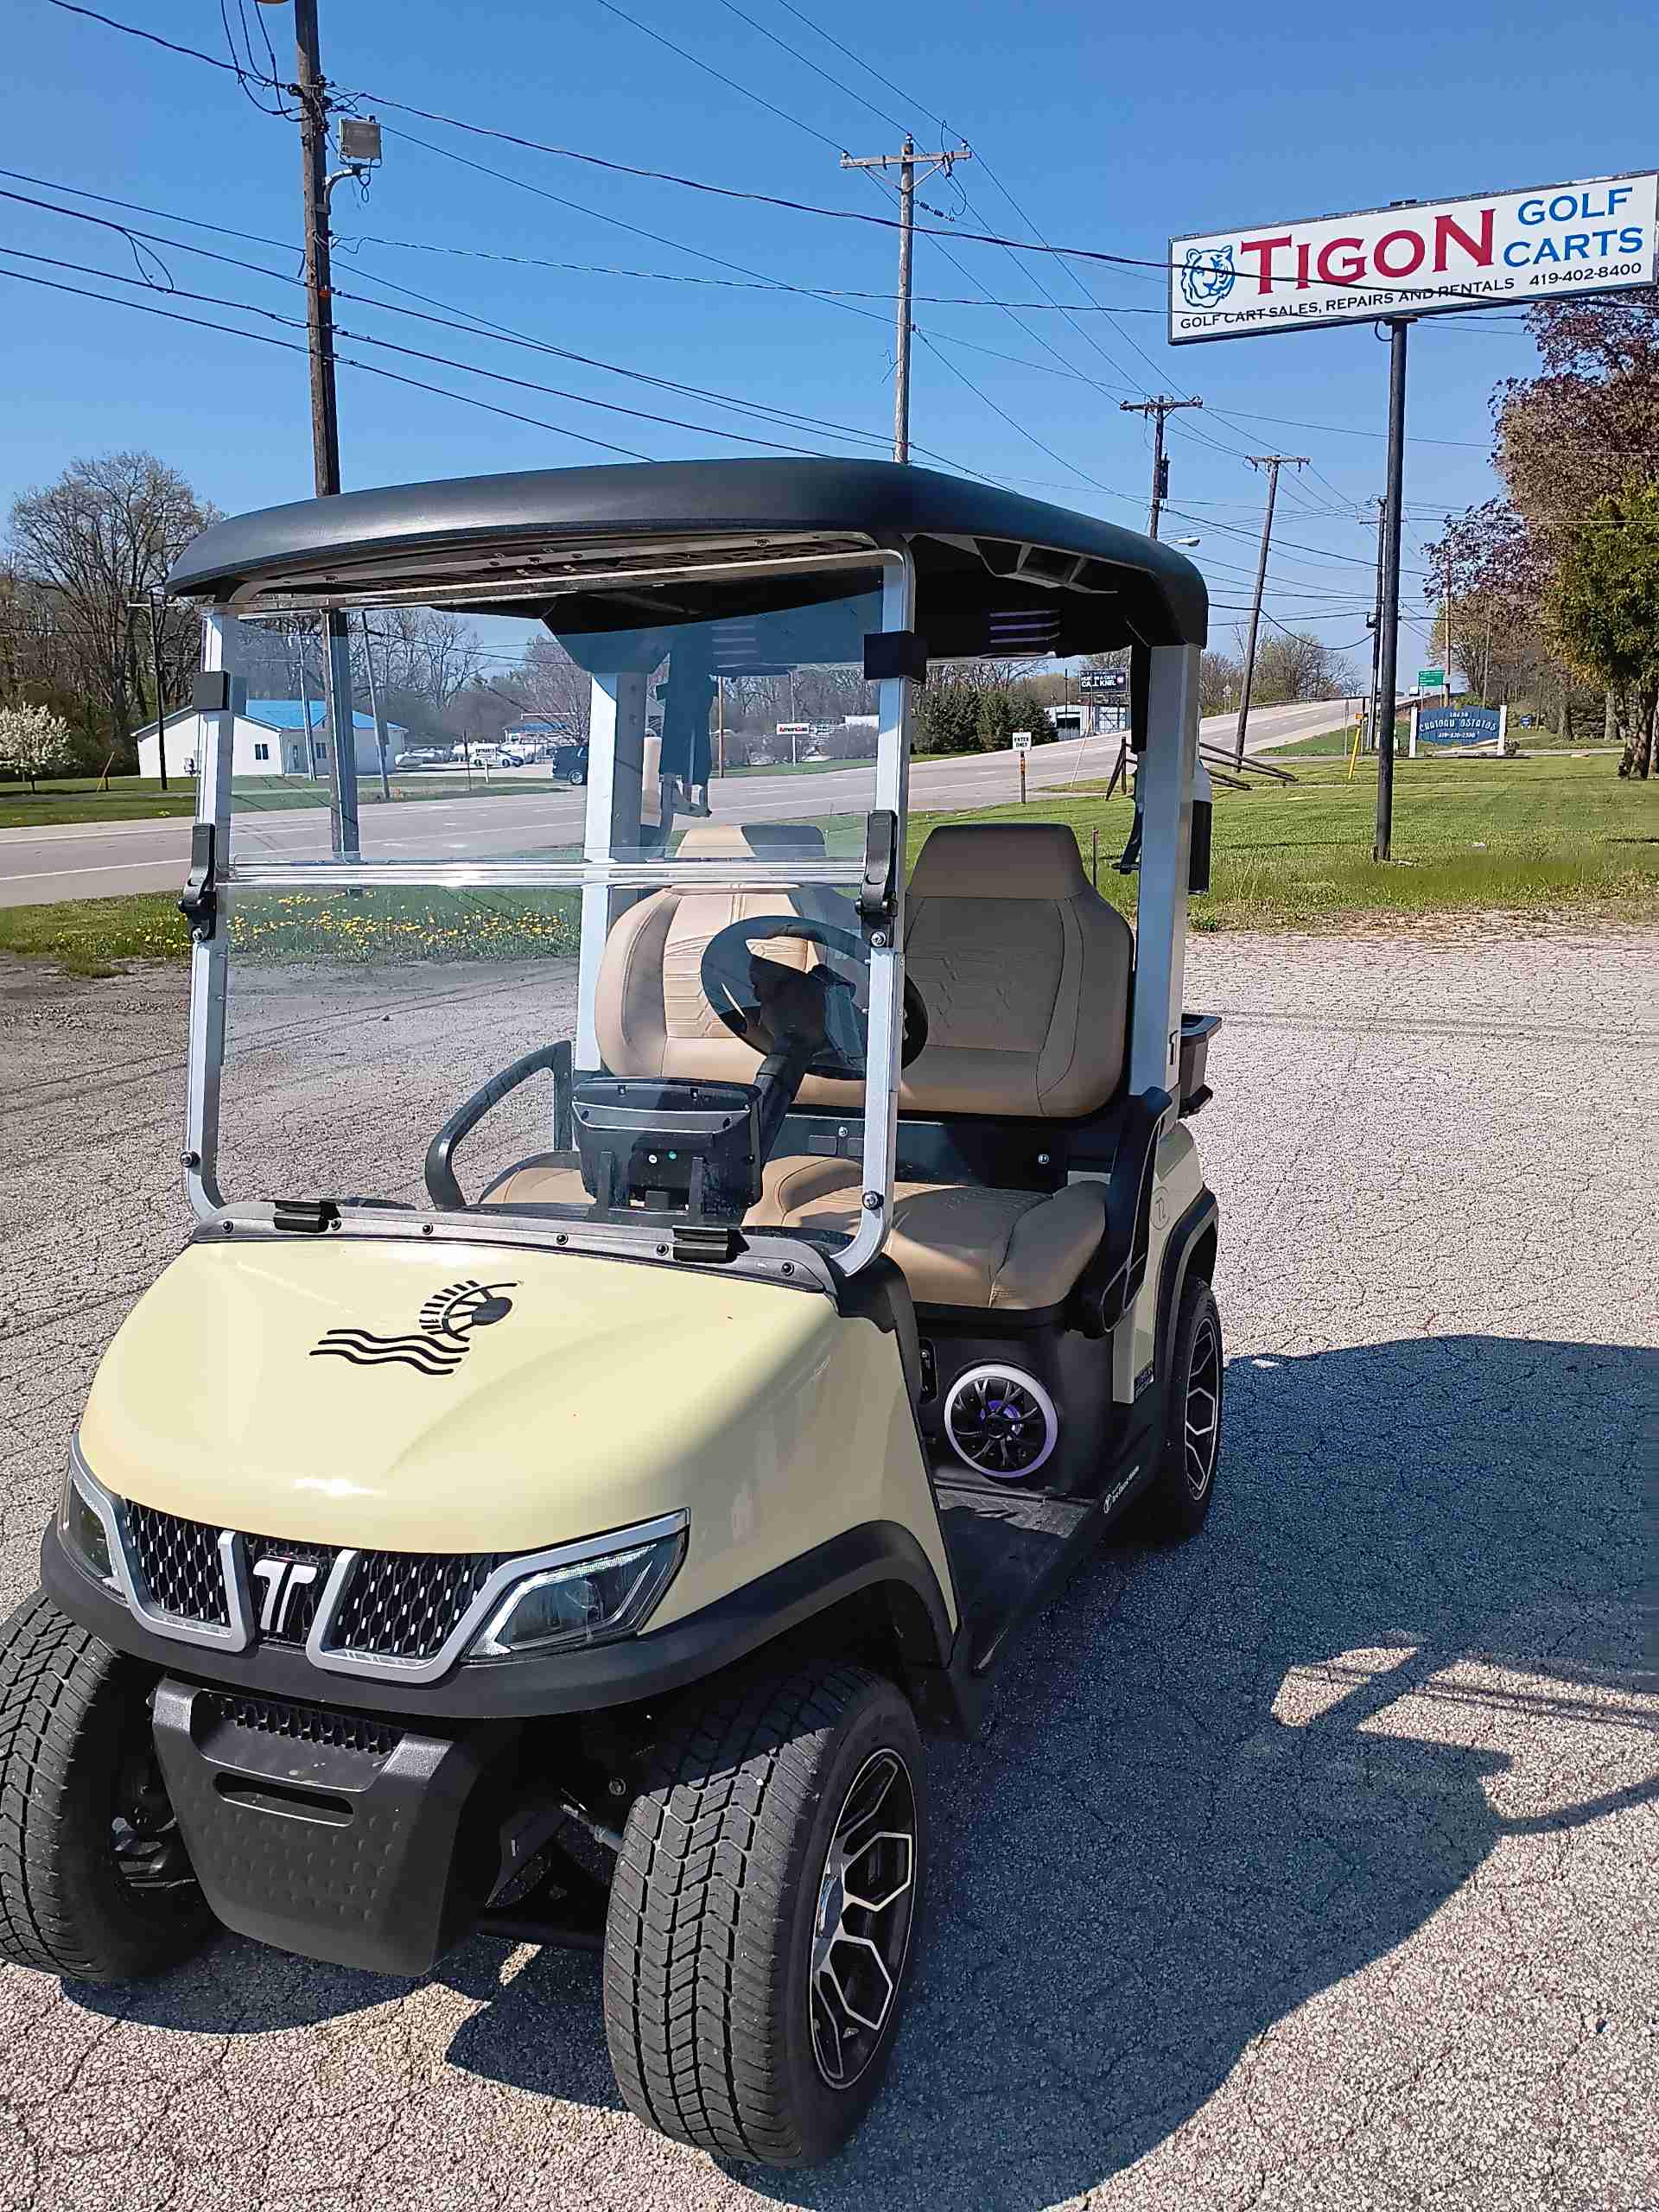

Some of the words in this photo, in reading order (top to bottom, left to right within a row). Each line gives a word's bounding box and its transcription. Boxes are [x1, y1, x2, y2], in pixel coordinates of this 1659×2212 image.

[1240, 208, 1497, 296] TIGON
[1517, 187, 1634, 226] GOLF
[1503, 227, 1643, 268] CARTS
[1529, 262, 1642, 286] 419-402-8400
[1180, 315, 1220, 329] GOLF
[1224, 308, 1266, 323] CART
[1269, 302, 1322, 317] SALES,
[1326, 292, 1394, 312] REPAIRS
[1397, 288, 1434, 304] AND
[1439, 277, 1515, 297] RENTALS
